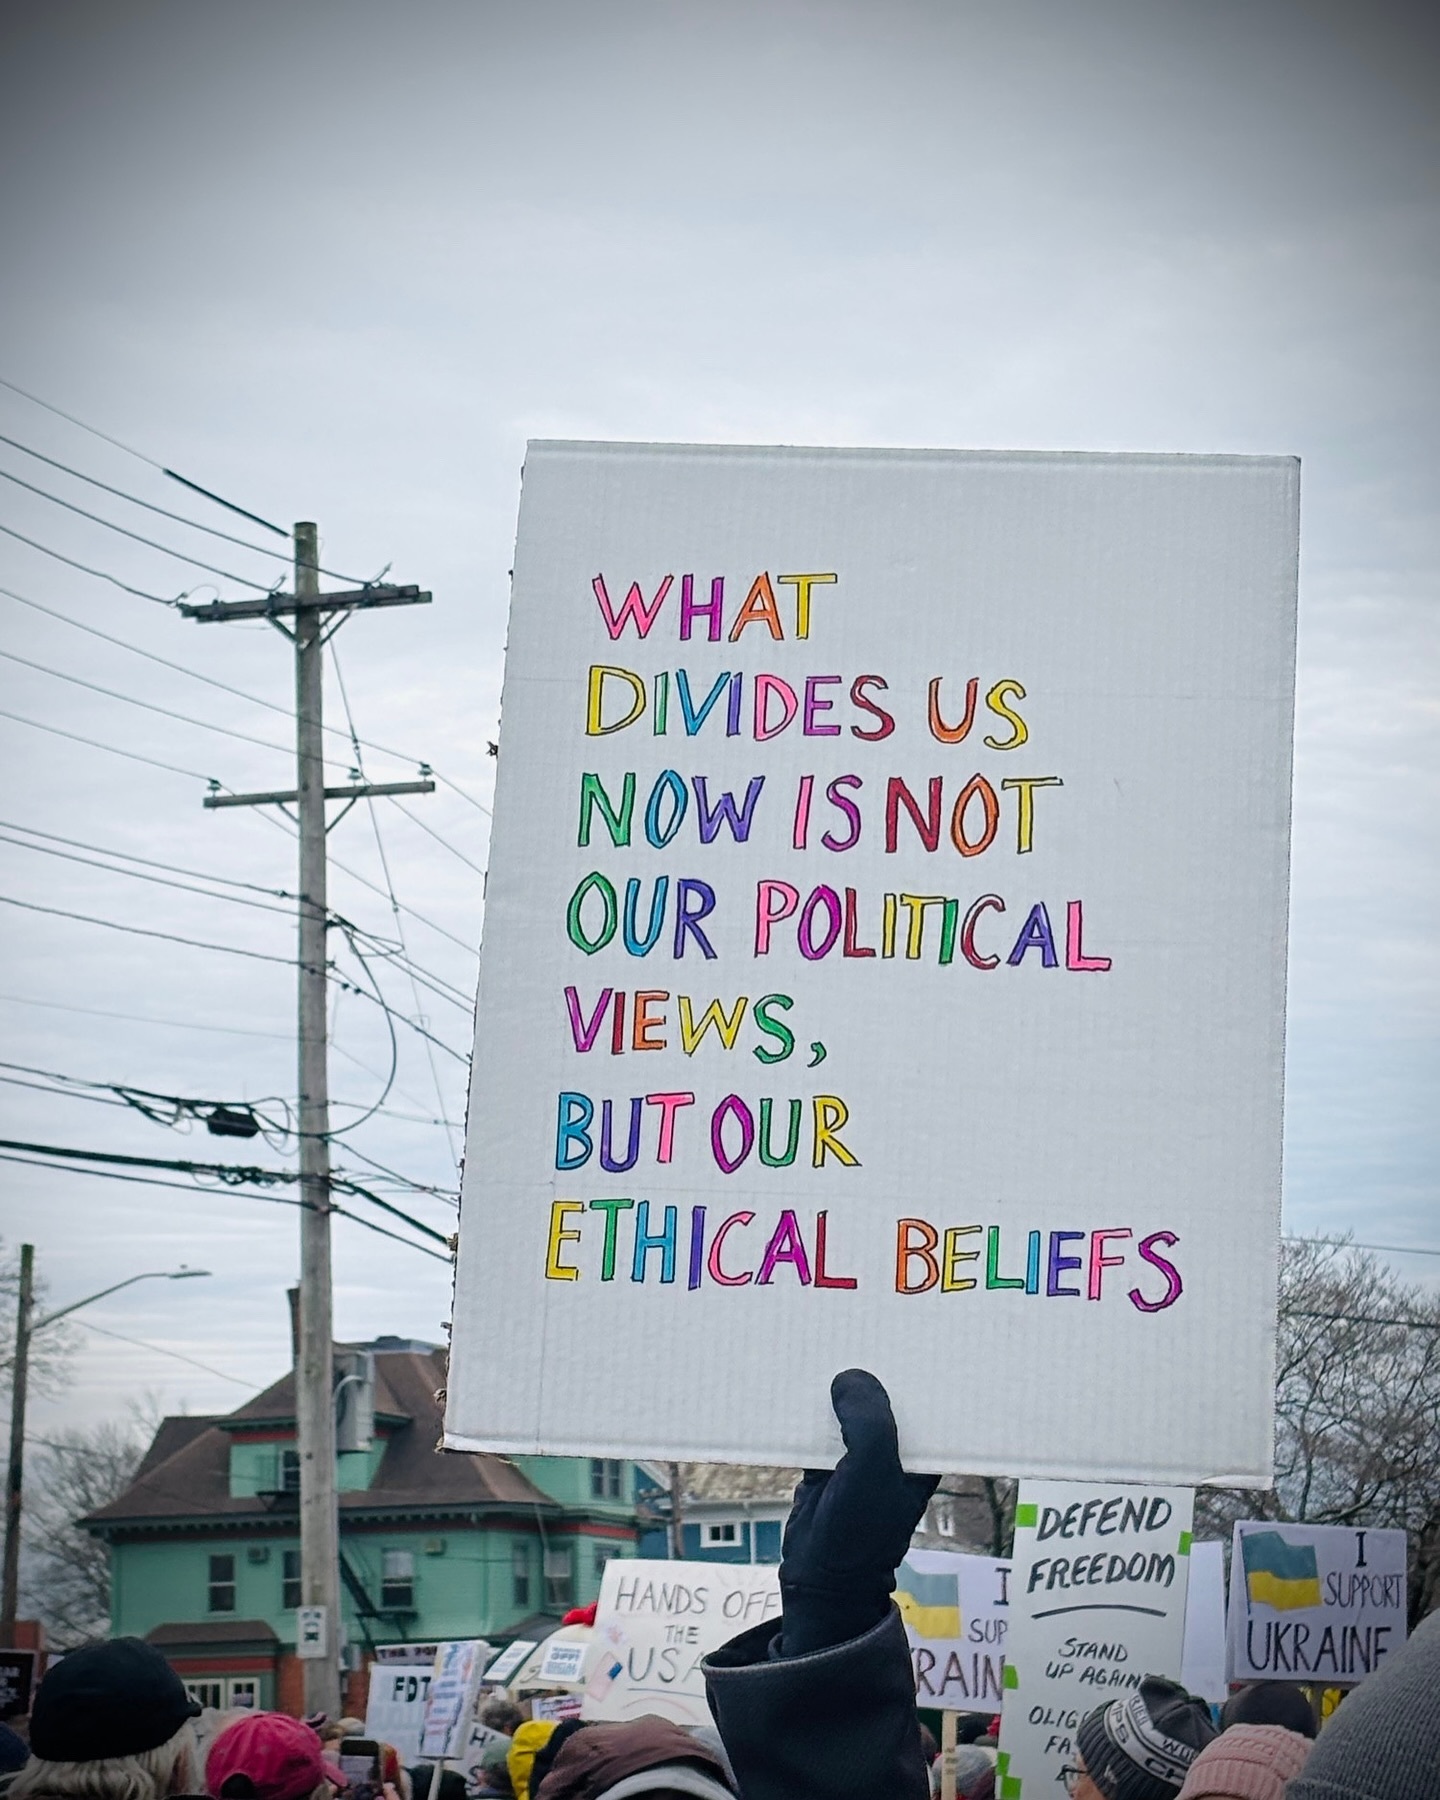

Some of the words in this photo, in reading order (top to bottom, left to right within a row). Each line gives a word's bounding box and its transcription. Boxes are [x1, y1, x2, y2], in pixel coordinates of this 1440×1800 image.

[591, 571, 838, 642] WHAT
[584, 665, 896, 742] DIVIDES
[928, 676, 1030, 751] US
[577, 769, 765, 850] NOW
[792, 774, 863, 853] IS
[885, 773, 1064, 858] NOT
[566, 870, 718, 961] OUR
[754, 877, 1113, 973] POLITICAL
[563, 985, 828, 1068] VIEWS,
[555, 1092, 695, 1173] BUT
[711, 1093, 862, 1175] OUR
[545, 1198, 858, 1291] ETHICAL
[894, 1217, 1184, 1313] BELIEFS
[1036, 1495, 1173, 1542] DEFEND
[1026, 1551, 1177, 1594] FREEDOM
[1355, 1530, 1368, 1568] I
[614, 1574, 710, 1615] HANDS
[722, 1588, 781, 1621] OFF
[992, 1566, 1012, 1606] I
[1323, 1571, 1404, 1609] SUPPORT
[664, 1623, 700, 1645] THE
[1057, 1636, 1129, 1663] STAND
[392, 1675, 432, 1703] FDT
[1045, 1661, 1074, 1680] UP
[1078, 1665, 1146, 1691] AGAIN
